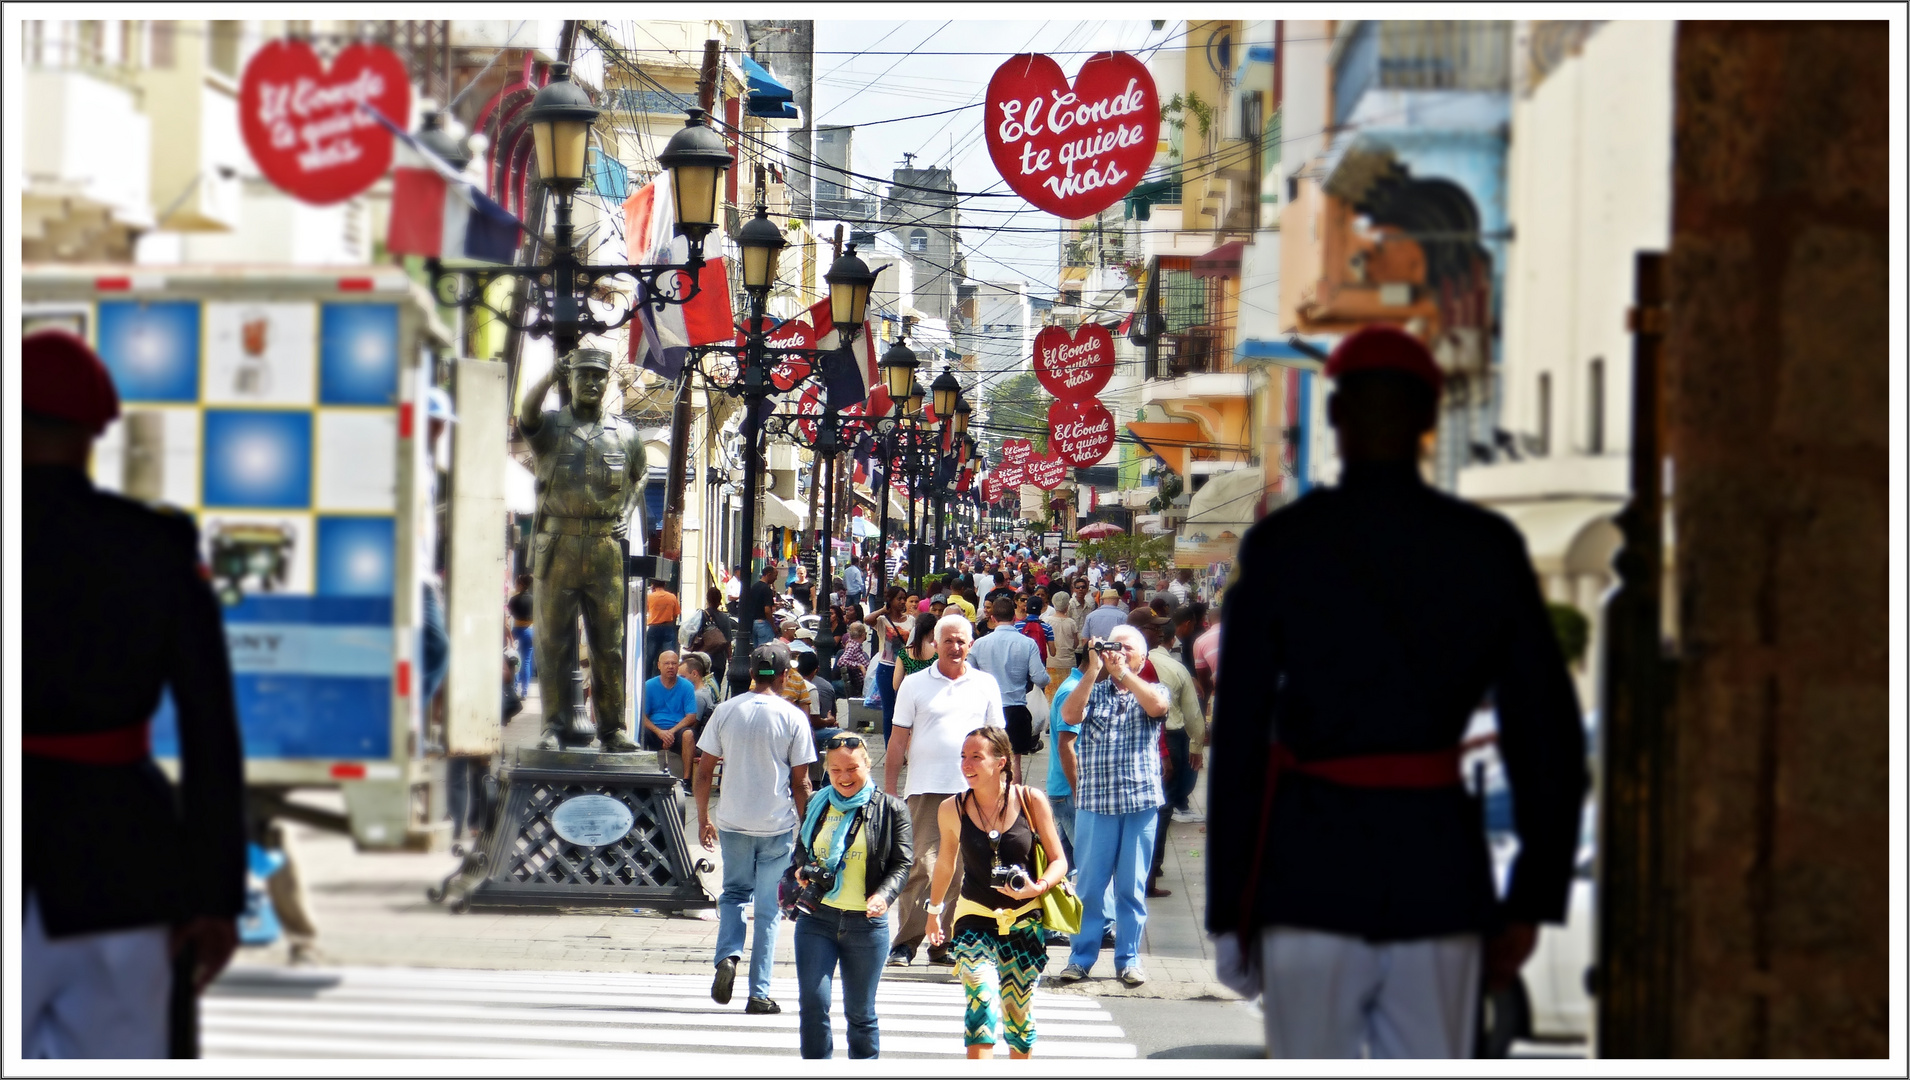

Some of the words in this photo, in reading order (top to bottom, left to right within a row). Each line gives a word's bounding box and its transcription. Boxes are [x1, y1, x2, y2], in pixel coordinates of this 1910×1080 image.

[999, 97, 1043, 144] El
[1047, 78, 1145, 134] Conde
[1019, 141, 1052, 175] te
[1058, 124, 1144, 177] quiere
[1042, 159, 1128, 200] más
[1042, 347, 1057, 370] El
[1058, 336, 1101, 362] Conde
[1050, 365, 1063, 379] te
[1064, 353, 1100, 377] quiere
[1063, 370, 1094, 388] más
[1054, 424, 1071, 441] El
[1072, 418, 1109, 438] Conde
[1061, 440, 1074, 453] te
[1075, 434, 1108, 454] quiere
[1069, 448, 1102, 462] más
[1028, 463, 1039, 474] El
